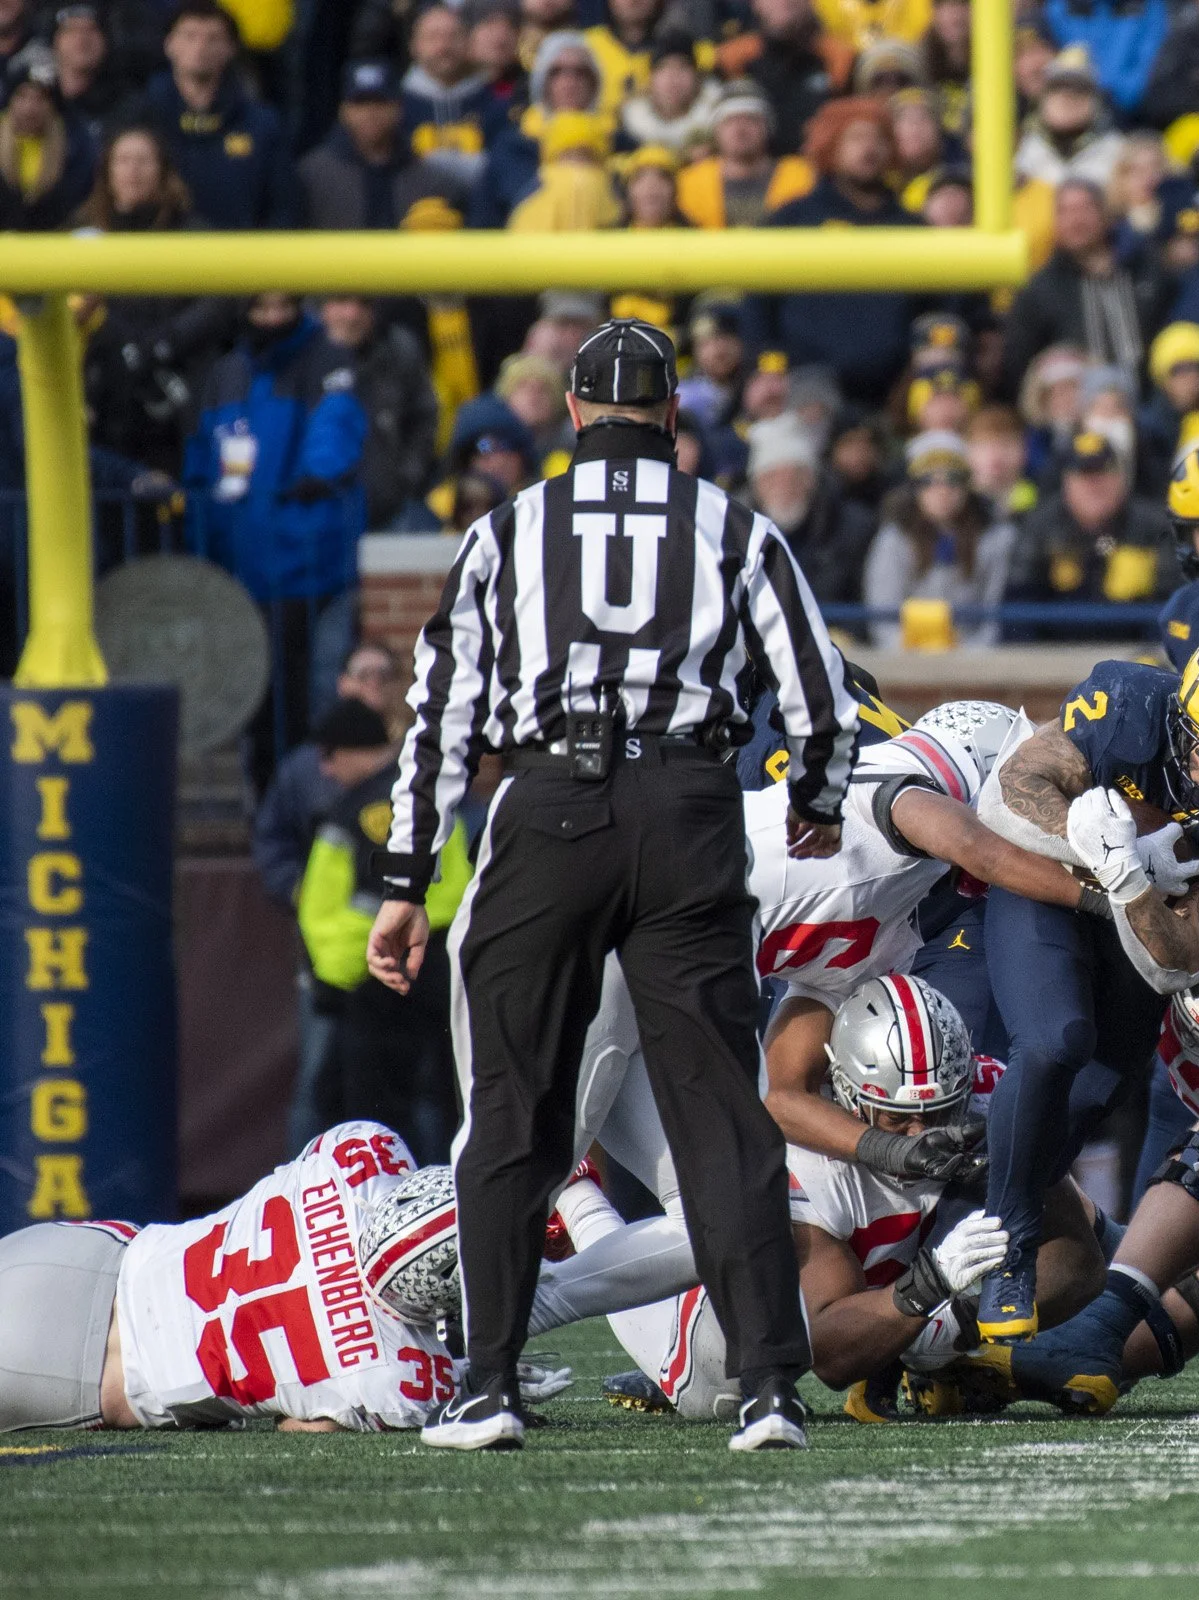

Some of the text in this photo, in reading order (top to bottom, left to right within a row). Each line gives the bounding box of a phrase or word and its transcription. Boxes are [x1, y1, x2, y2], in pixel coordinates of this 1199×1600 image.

[572, 513, 667, 634] U
[1063, 691, 1109, 733] 2
[625, 738, 642, 760] S
[332, 1134, 410, 1188] 35
[183, 1195, 331, 1406] 35
[302, 1177, 379, 1369] EICHENBERG
[397, 1346, 456, 1402] 35
